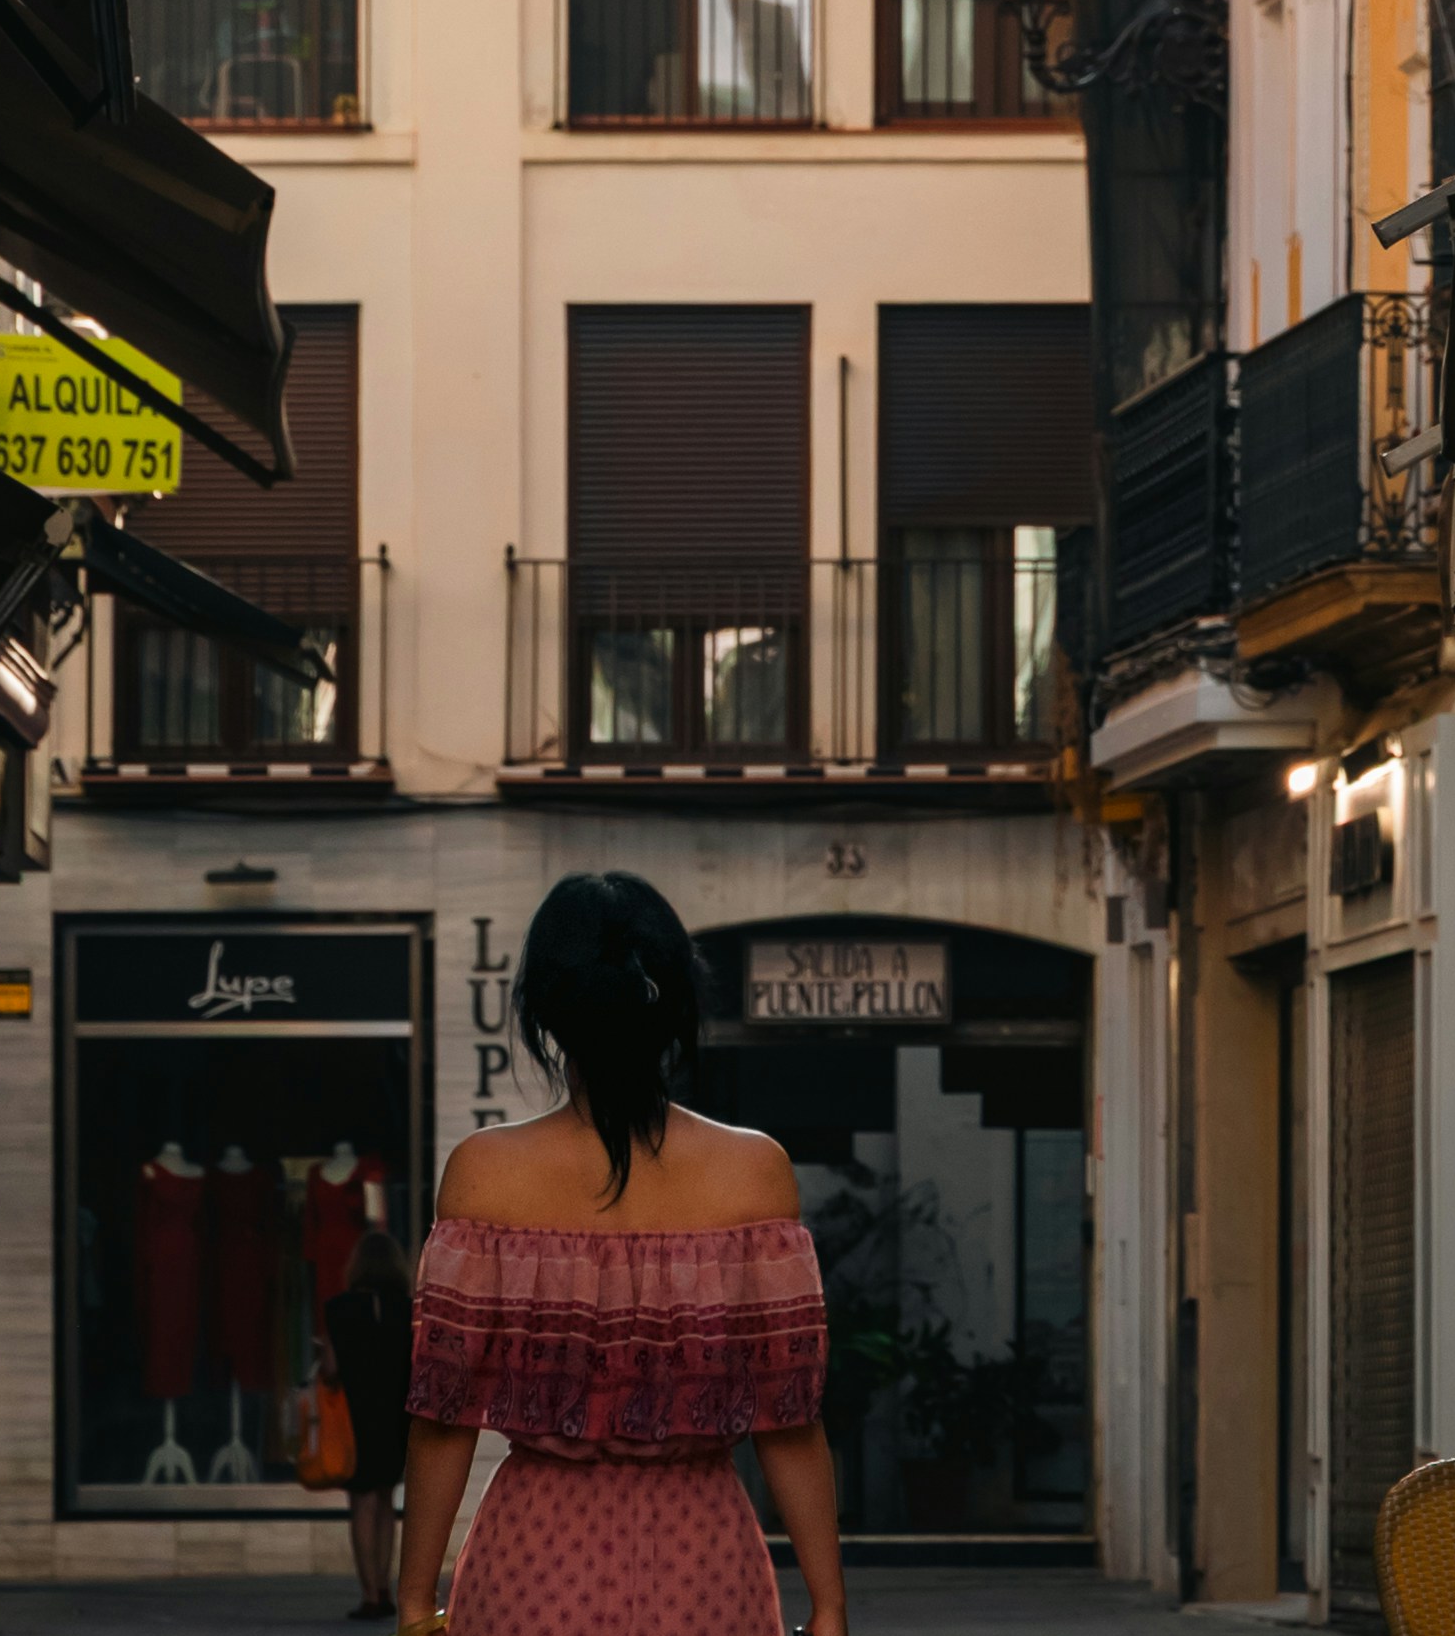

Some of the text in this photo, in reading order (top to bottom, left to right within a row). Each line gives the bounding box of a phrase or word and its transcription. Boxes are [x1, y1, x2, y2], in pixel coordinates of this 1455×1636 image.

[56, 436, 112, 478] 630
[121, 438, 174, 481] 751
[186, 939, 297, 1021] Lupe
[785, 944, 909, 979] SALIDA A
[751, 981, 840, 1015] PUENTE
